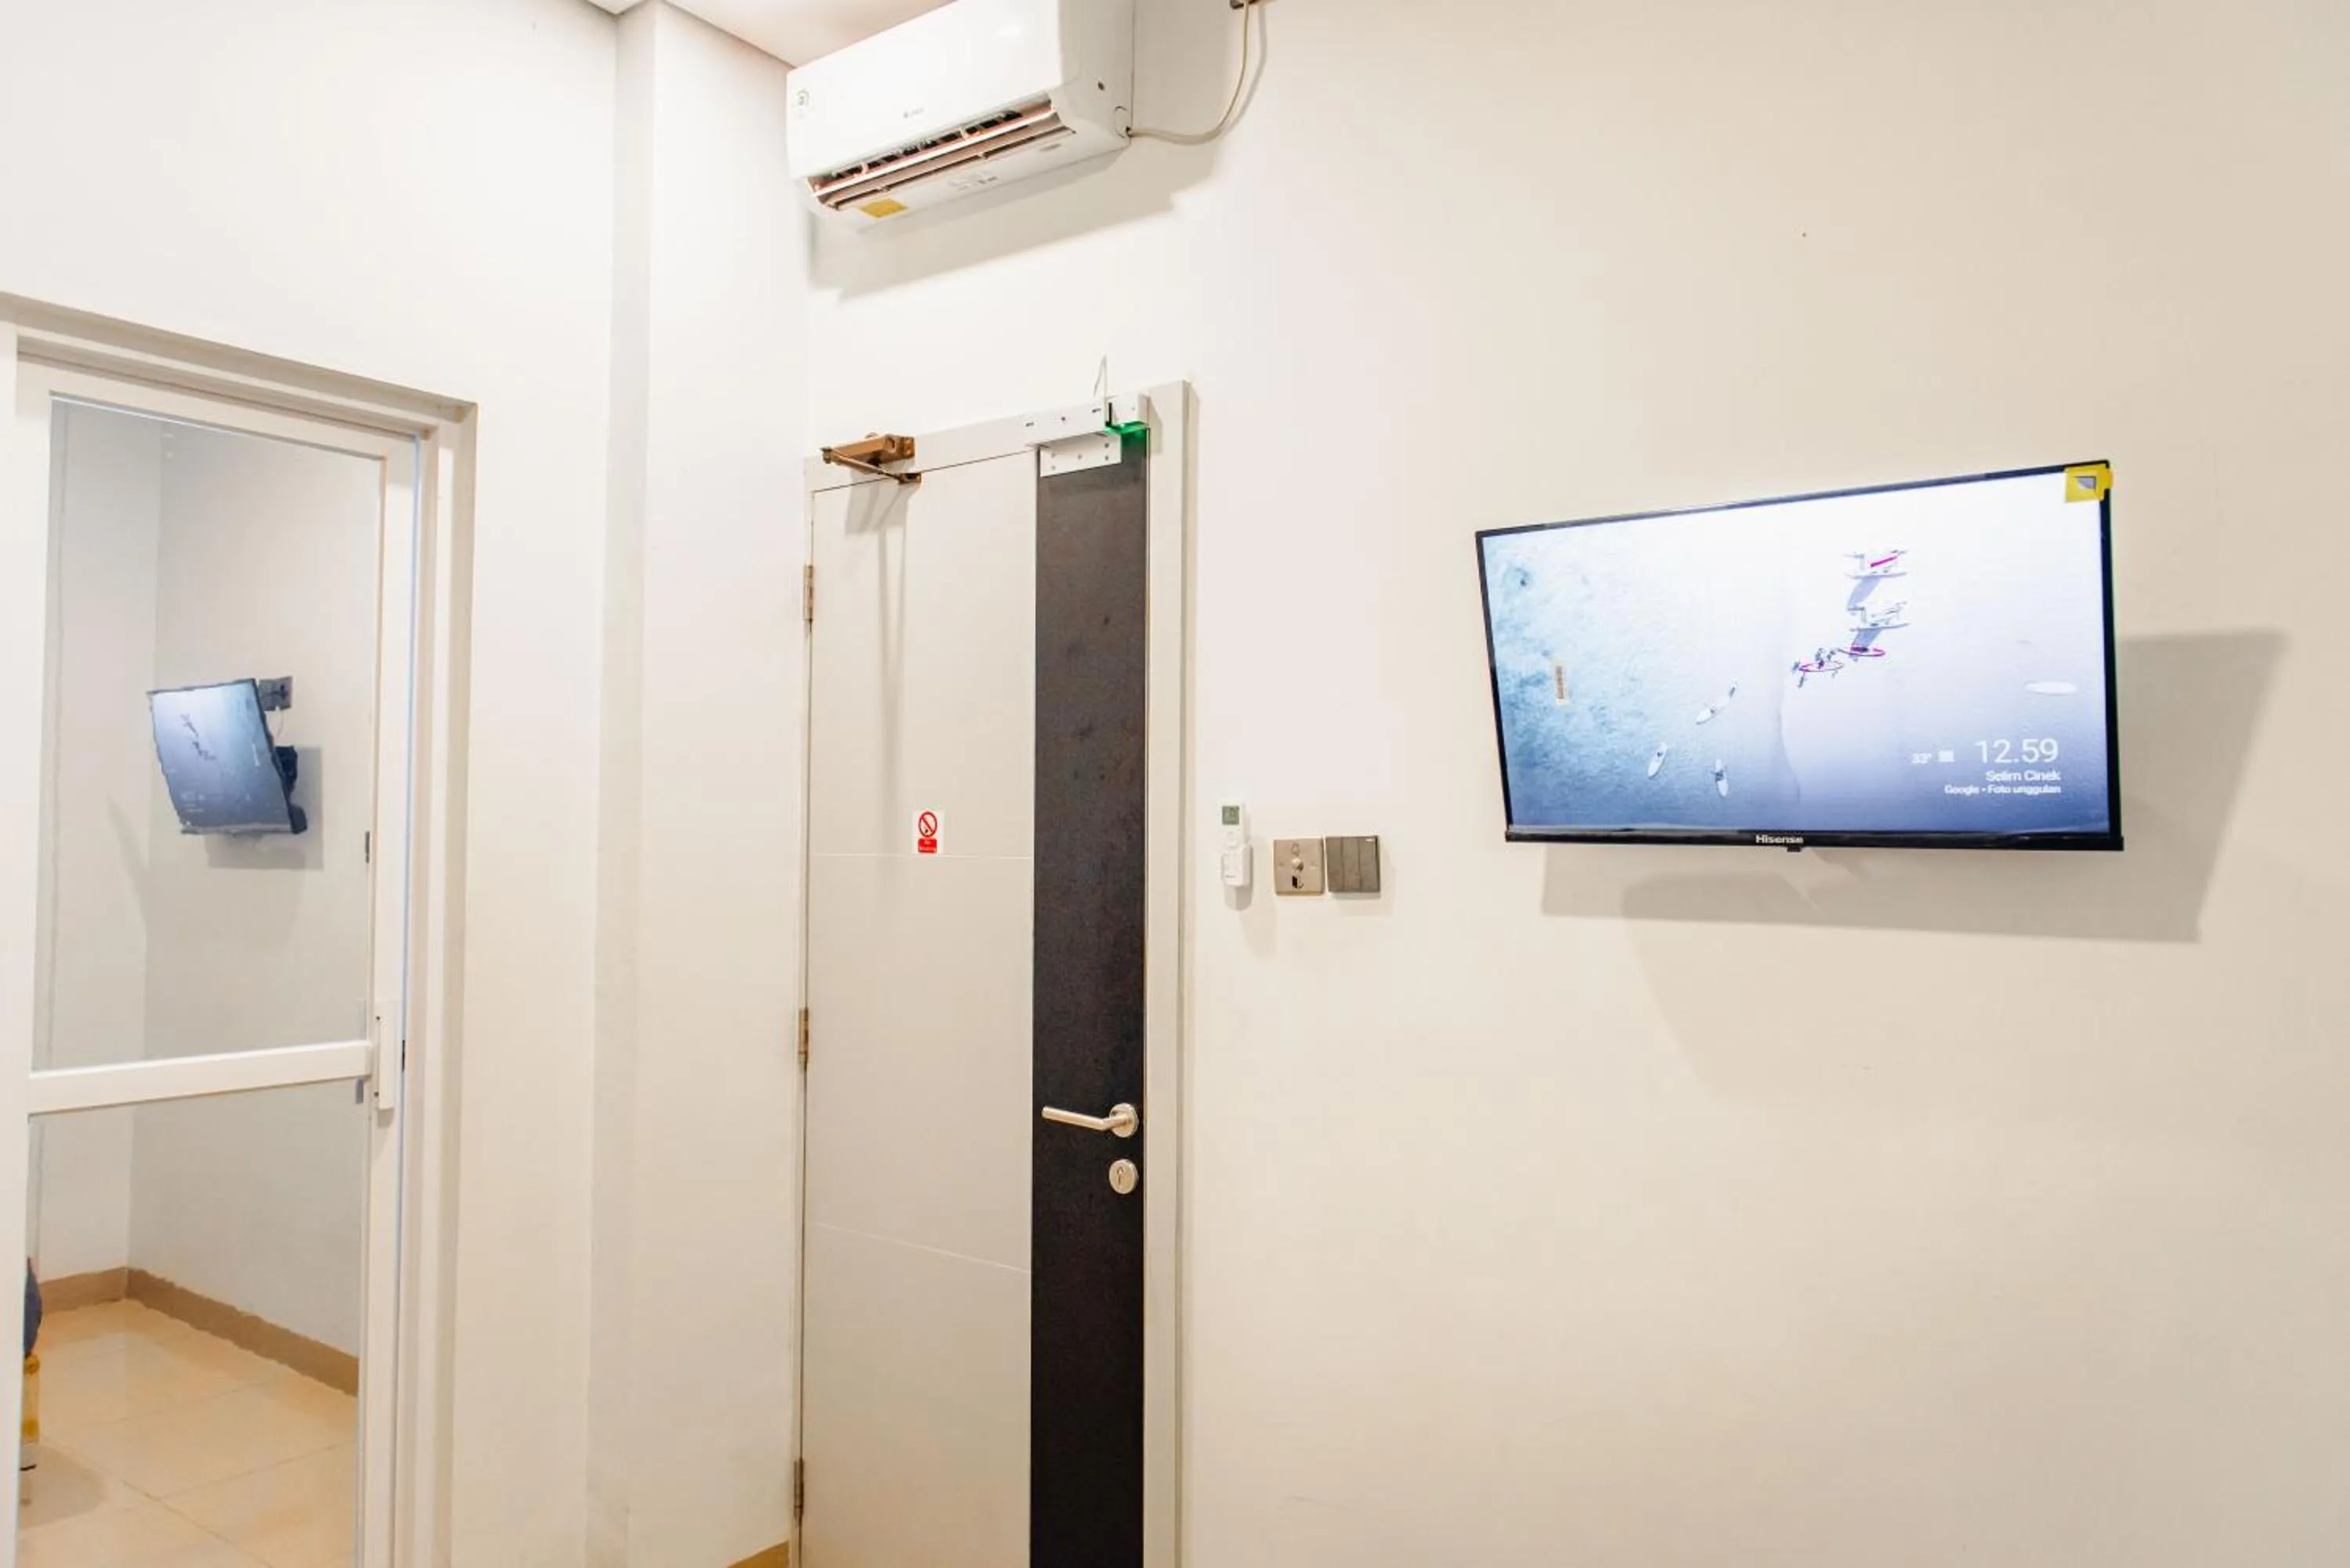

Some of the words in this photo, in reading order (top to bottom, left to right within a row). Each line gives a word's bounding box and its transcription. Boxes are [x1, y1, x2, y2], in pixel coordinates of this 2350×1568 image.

[1975, 739, 2059, 764] 12.59
[1944, 784, 1979, 796] Google
[1755, 834, 1804, 844] Hisense
